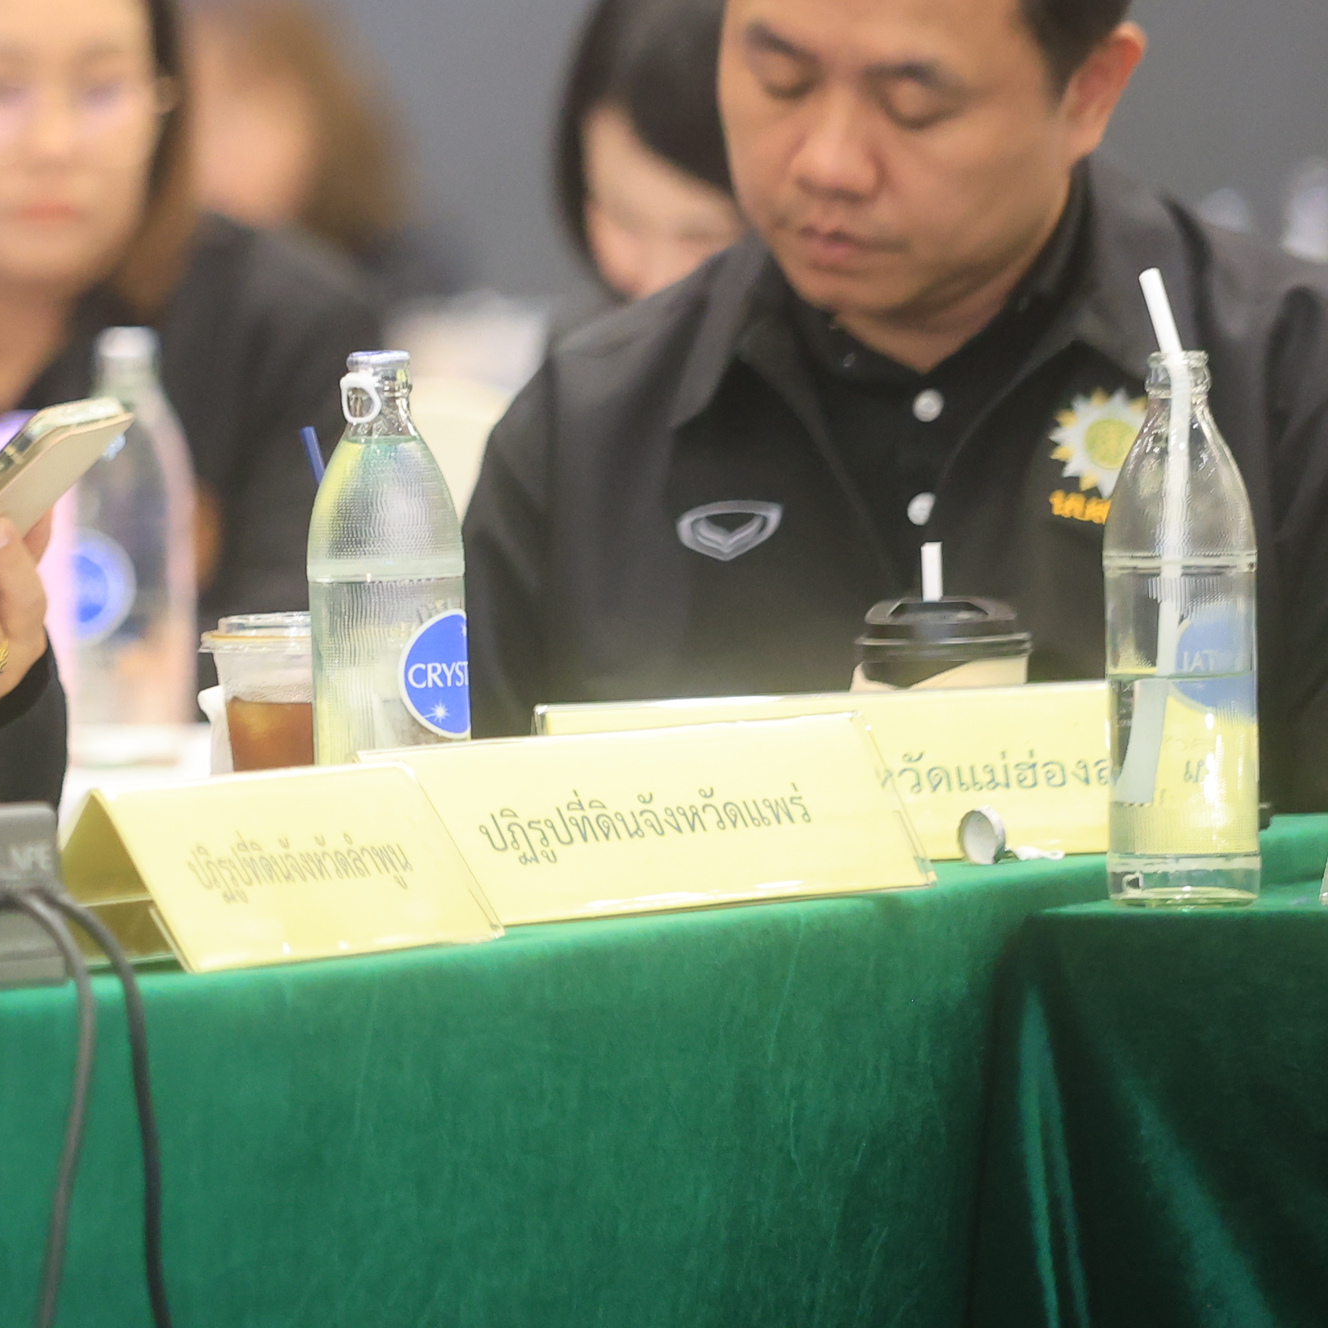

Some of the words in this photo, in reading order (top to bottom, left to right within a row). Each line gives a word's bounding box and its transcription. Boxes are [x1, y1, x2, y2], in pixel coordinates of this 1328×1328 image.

[478, 782, 812, 866] ปฏิรูปที่ดินจังหวัดแพร่
